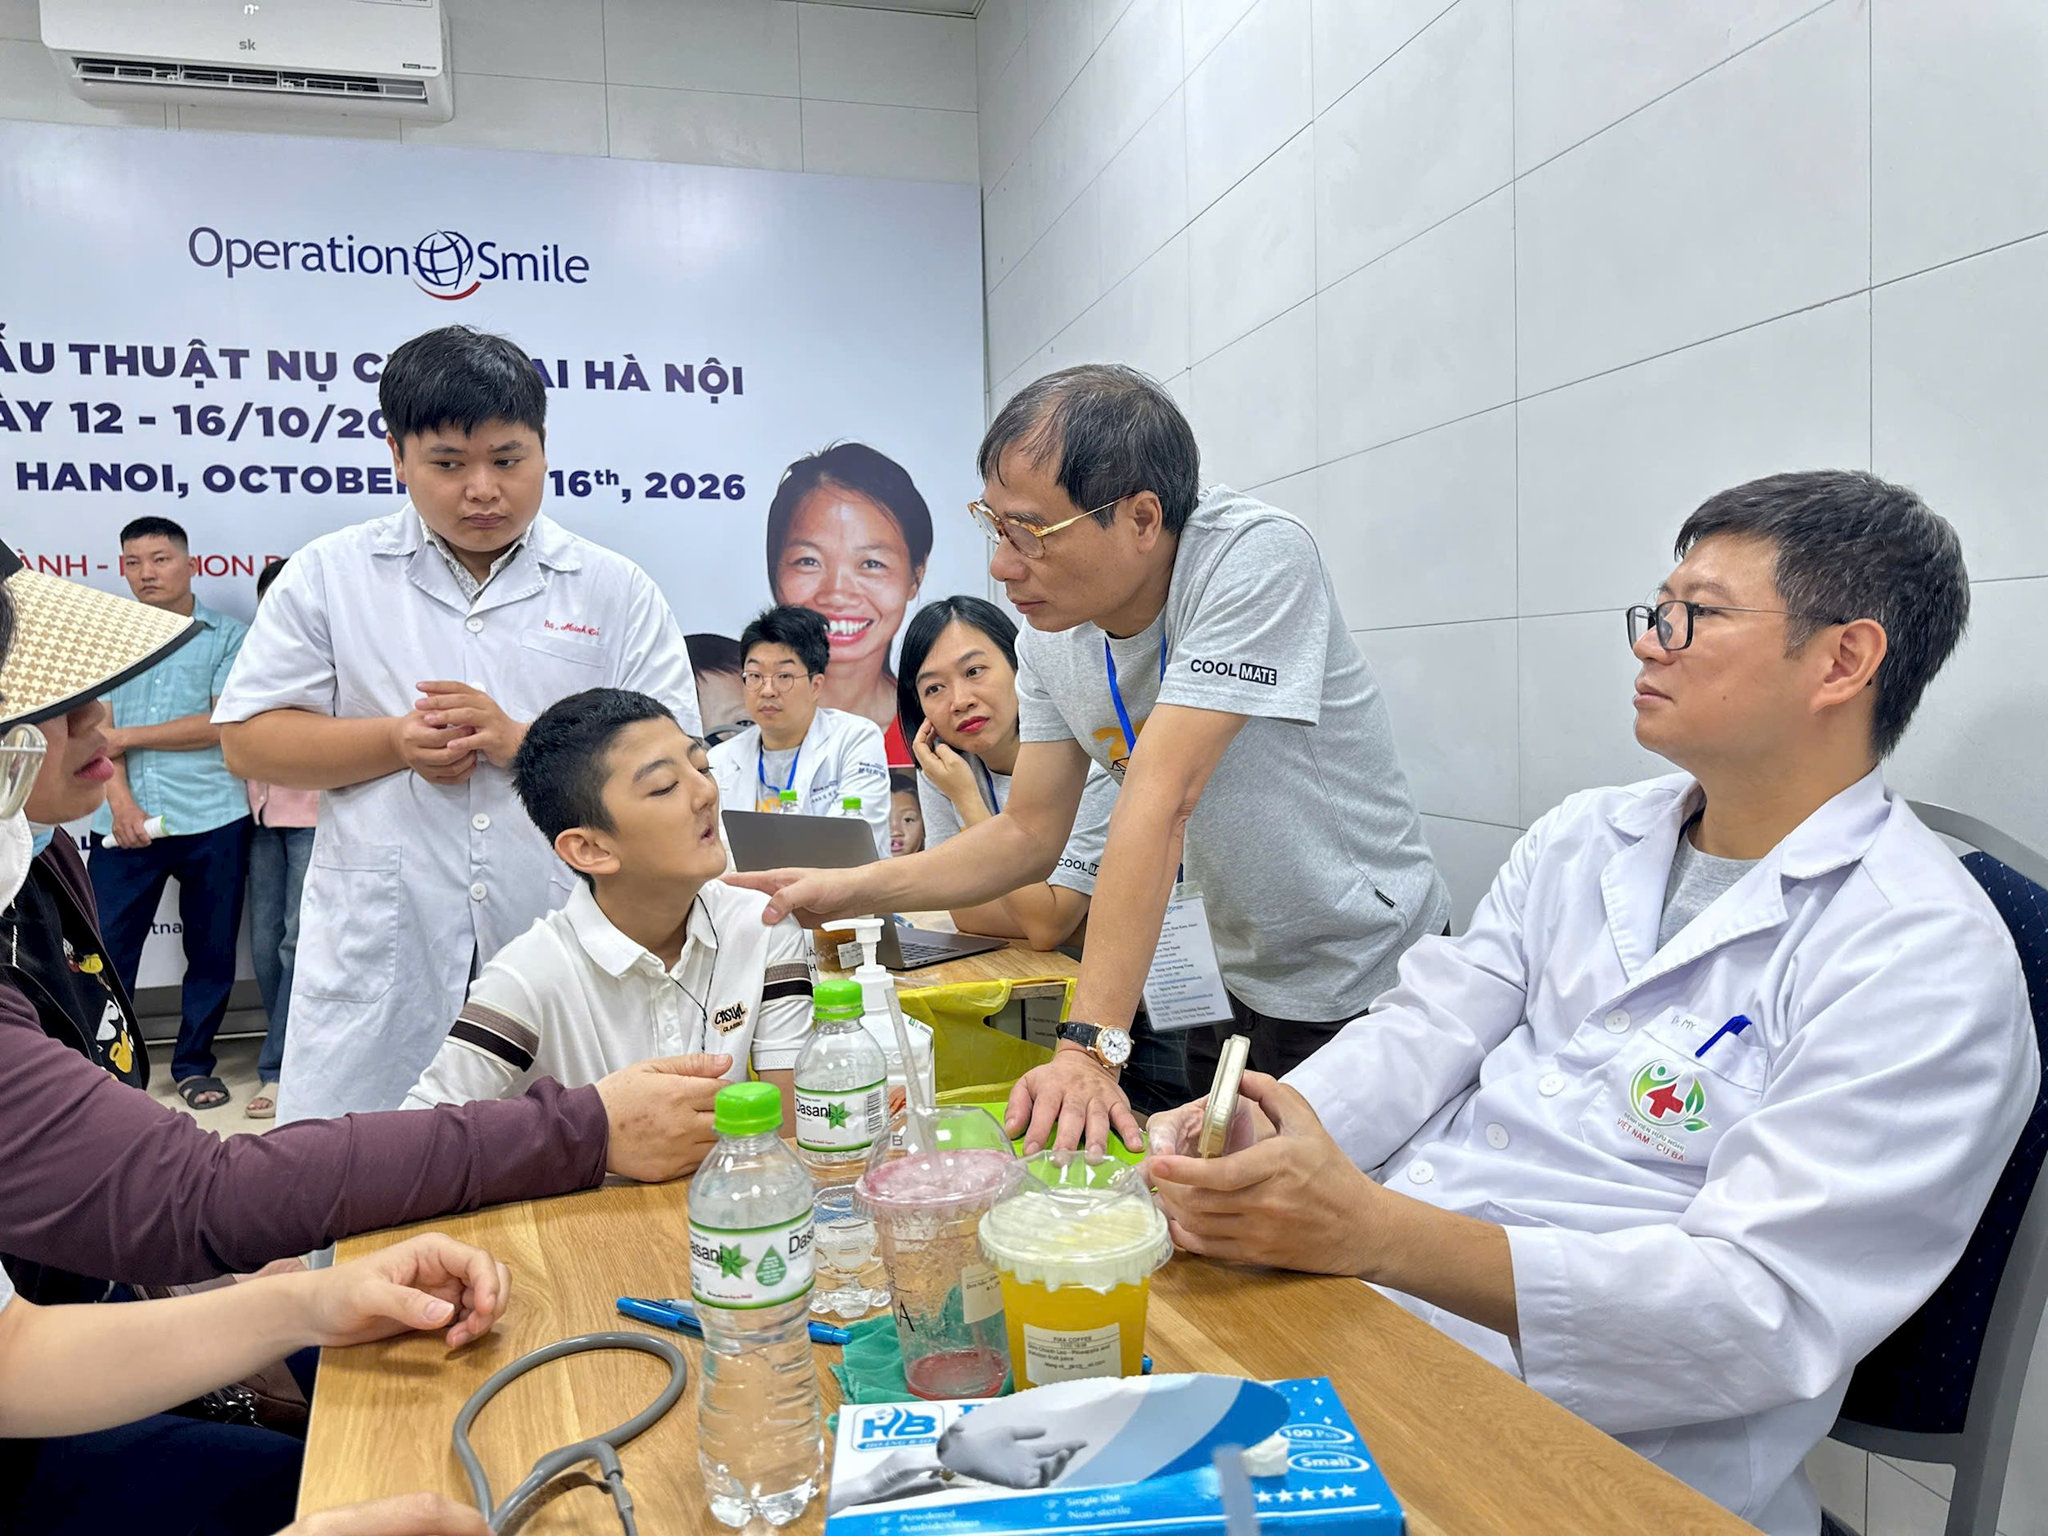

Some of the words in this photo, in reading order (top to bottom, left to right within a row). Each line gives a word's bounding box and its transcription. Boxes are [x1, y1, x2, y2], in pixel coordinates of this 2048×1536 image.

[188, 226, 410, 278] Operation
[477, 241, 590, 284] Smile
[68, 338, 250, 389] THUẬT
[267, 350, 338, 392] NỤ
[584, 353, 651, 392] HÀ
[664, 357, 744, 405] NỘI
[70, 401, 123, 434] 12
[16, 461, 189, 499] HANOI,
[644, 471, 746, 501] 2026
[1191, 659, 1237, 677] COOL
[1240, 663, 1277, 685] MATE
[1301, 1456, 1351, 1468] Small
